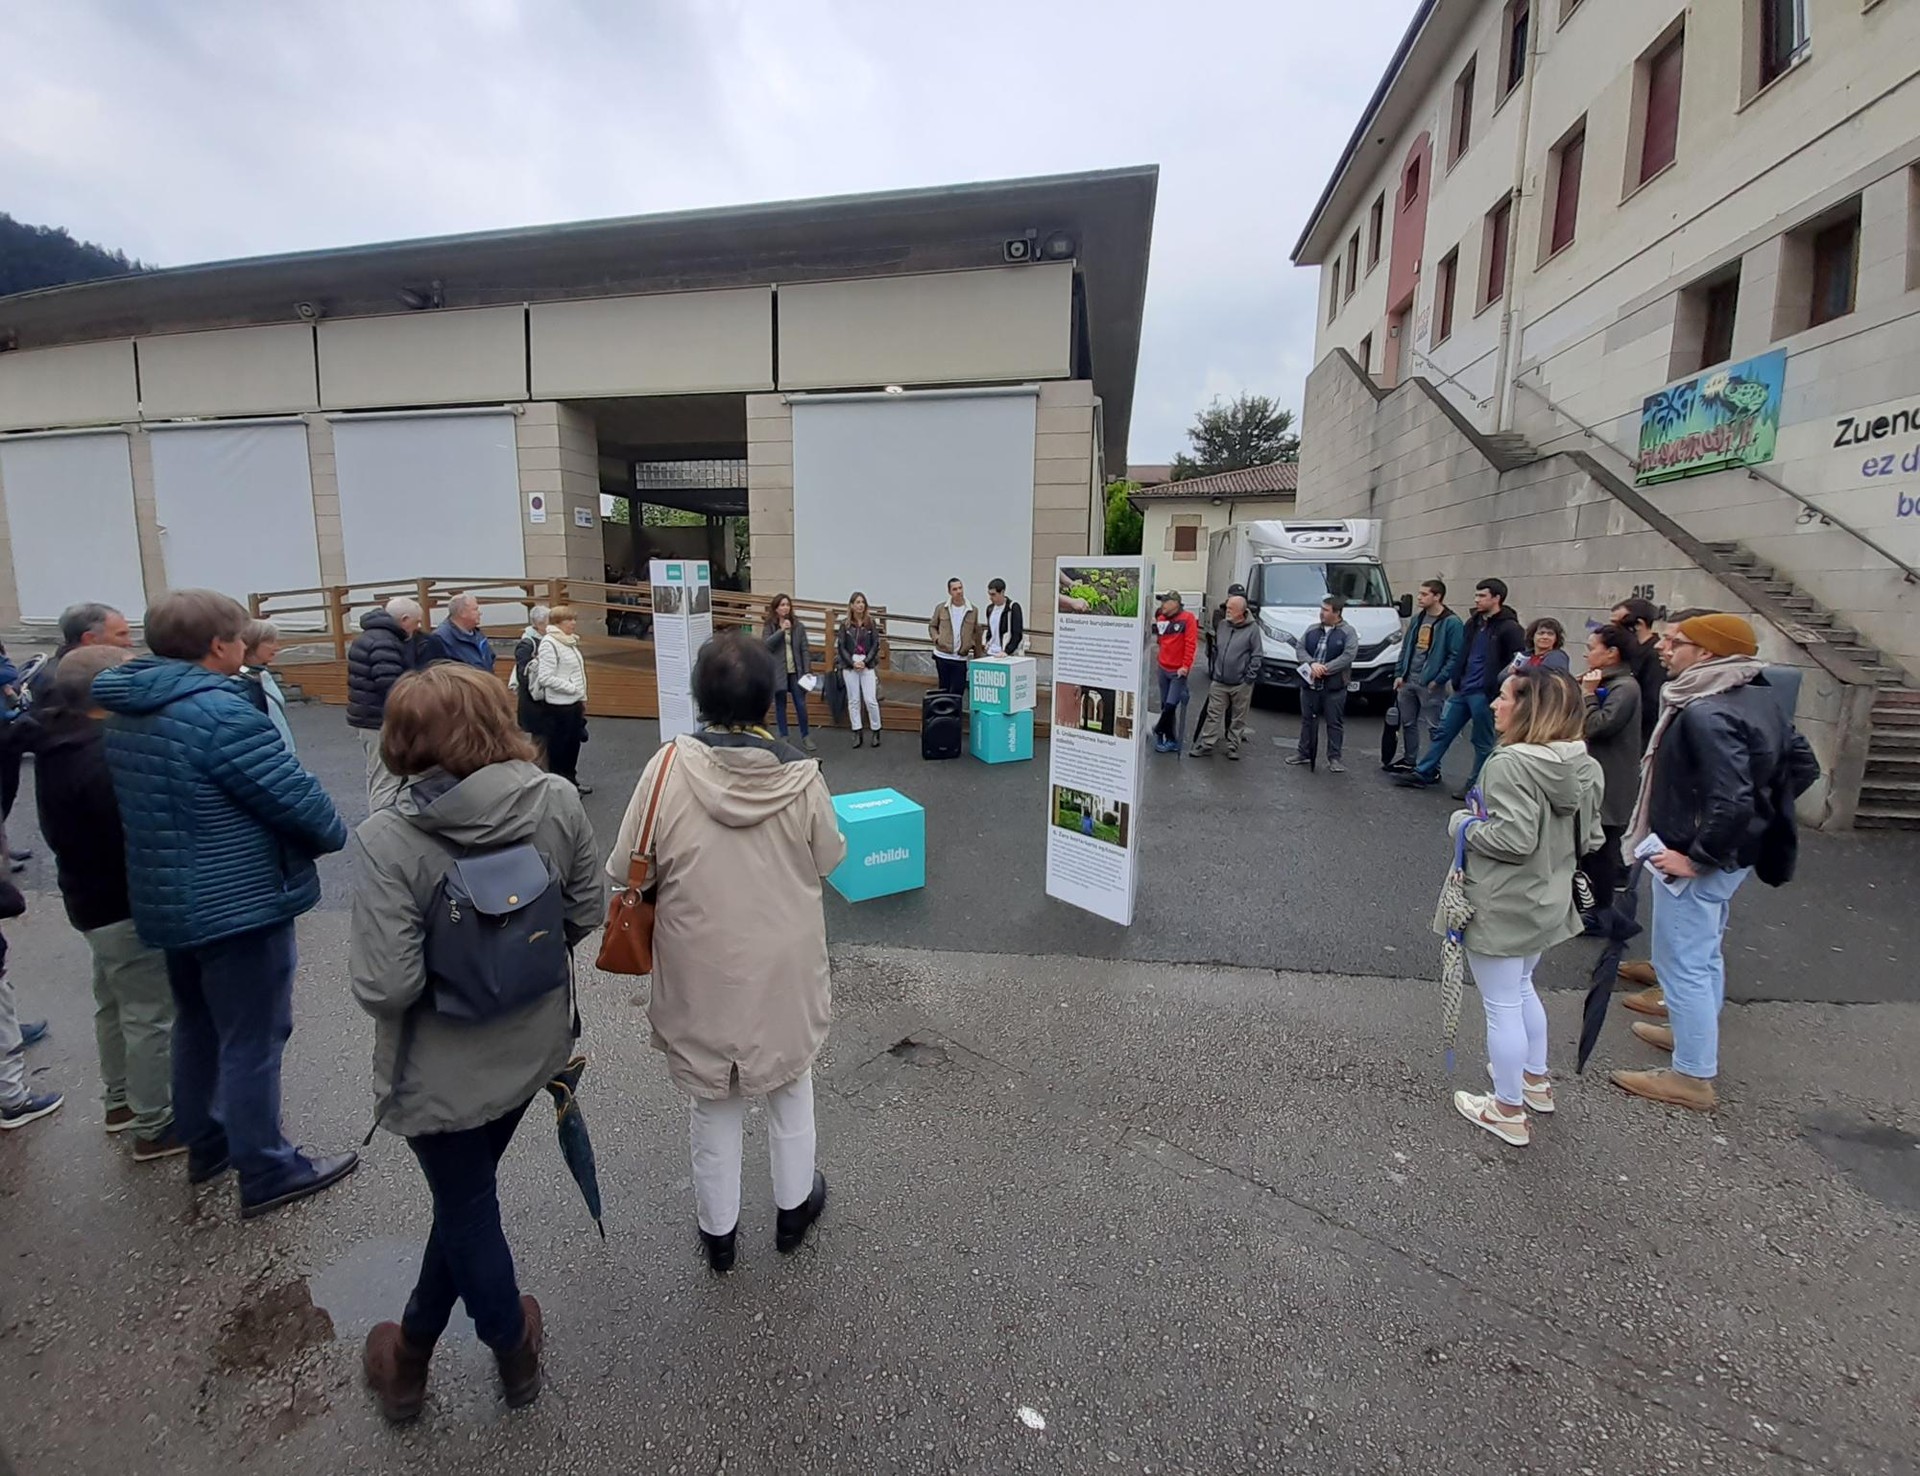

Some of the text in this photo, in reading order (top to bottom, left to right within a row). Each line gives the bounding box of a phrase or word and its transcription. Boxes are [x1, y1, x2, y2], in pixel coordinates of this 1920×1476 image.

[1861, 454, 1896, 477] ez
[973, 669, 1006, 687] EGINGO
[973, 686, 1001, 704] DUGU.
[864, 847, 910, 867] ehbildu
